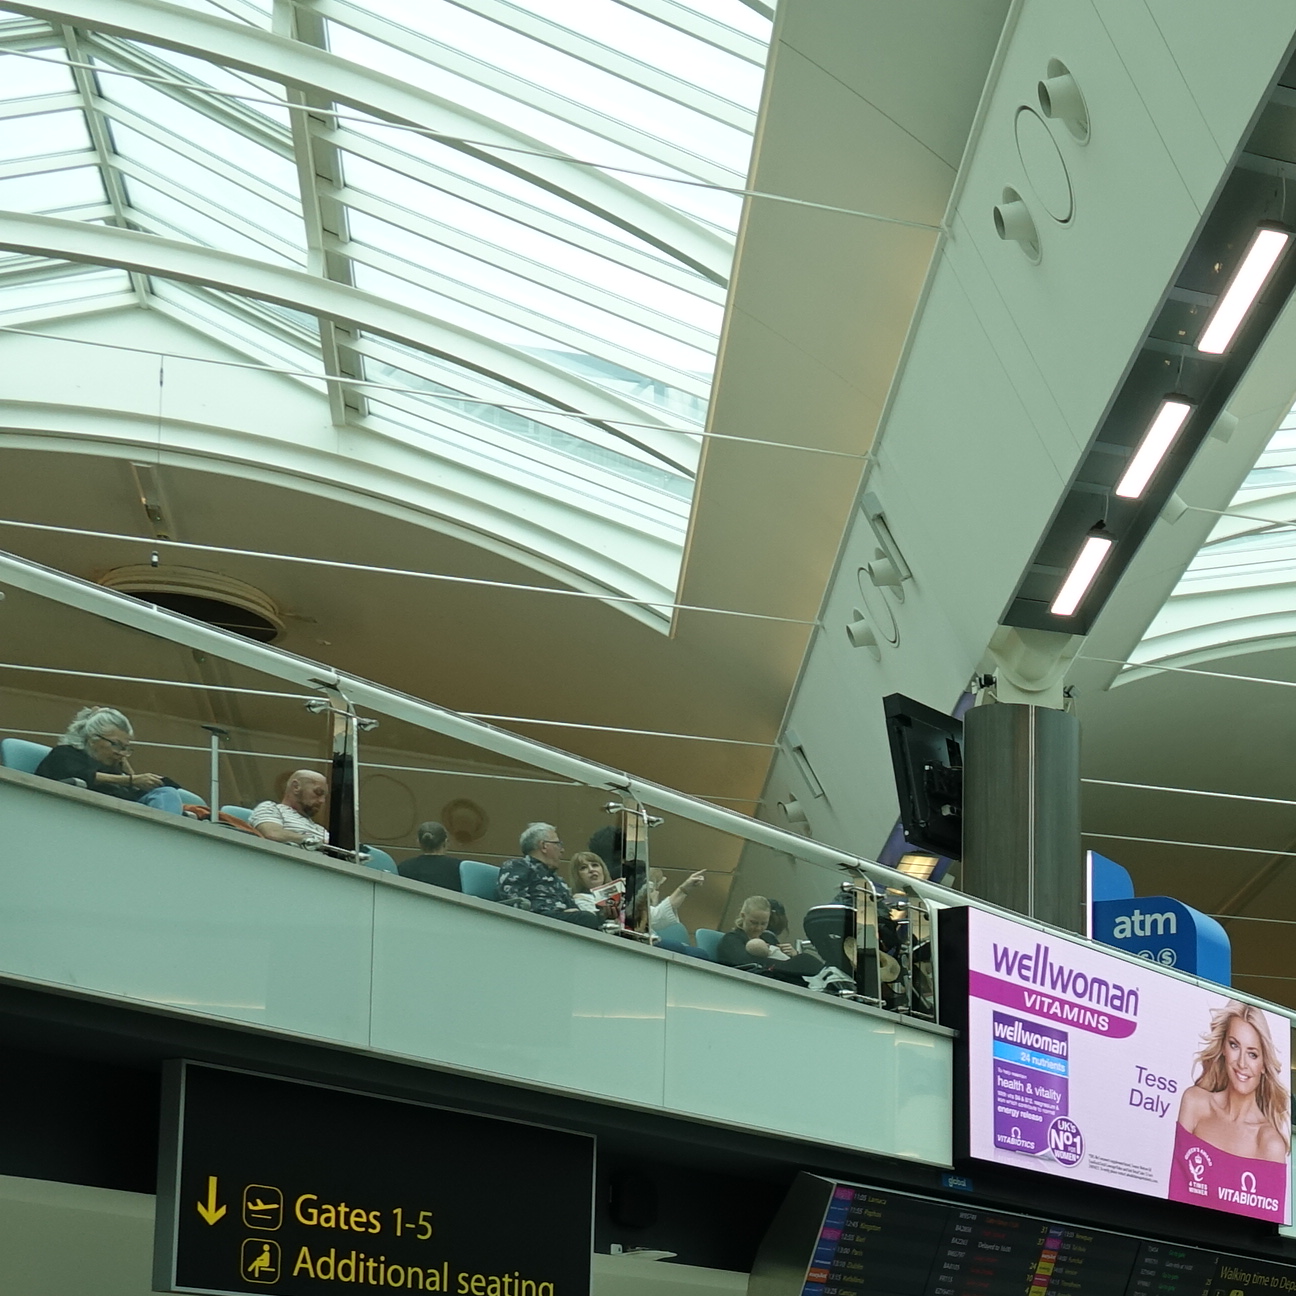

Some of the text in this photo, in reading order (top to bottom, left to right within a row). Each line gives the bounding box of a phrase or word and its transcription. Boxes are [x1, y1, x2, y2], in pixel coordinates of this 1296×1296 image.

[1113, 909, 1177, 939] atm
[993, 943, 1139, 1016] wellwoman
[1023, 991, 1110, 1031] VITAMINS
[994, 1021, 1067, 1056] wellwoman
[1021, 1052, 1066, 1073] 24 nutrients
[997, 1075, 1025, 1092] health
[1026, 1083, 1033, 1095] &
[1034, 1086, 1062, 1104] vitality
[1135, 1065, 1178, 1093] Tess
[997, 1105, 1020, 1118] energy
[1020, 1110, 1043, 1122] release
[1129, 1088, 1171, 1118] Daly
[997, 1134, 1035, 1149] VITABIOTICS
[1218, 1187, 1279, 1211] VITABIOTICS
[294, 1193, 433, 1240] Gates 1-5
[292, 1246, 449, 1292] Additional
[1220, 1266, 1251, 1286] Walking
[1252, 1272, 1270, 1286] time
[1270, 1277, 1279, 1288] to
